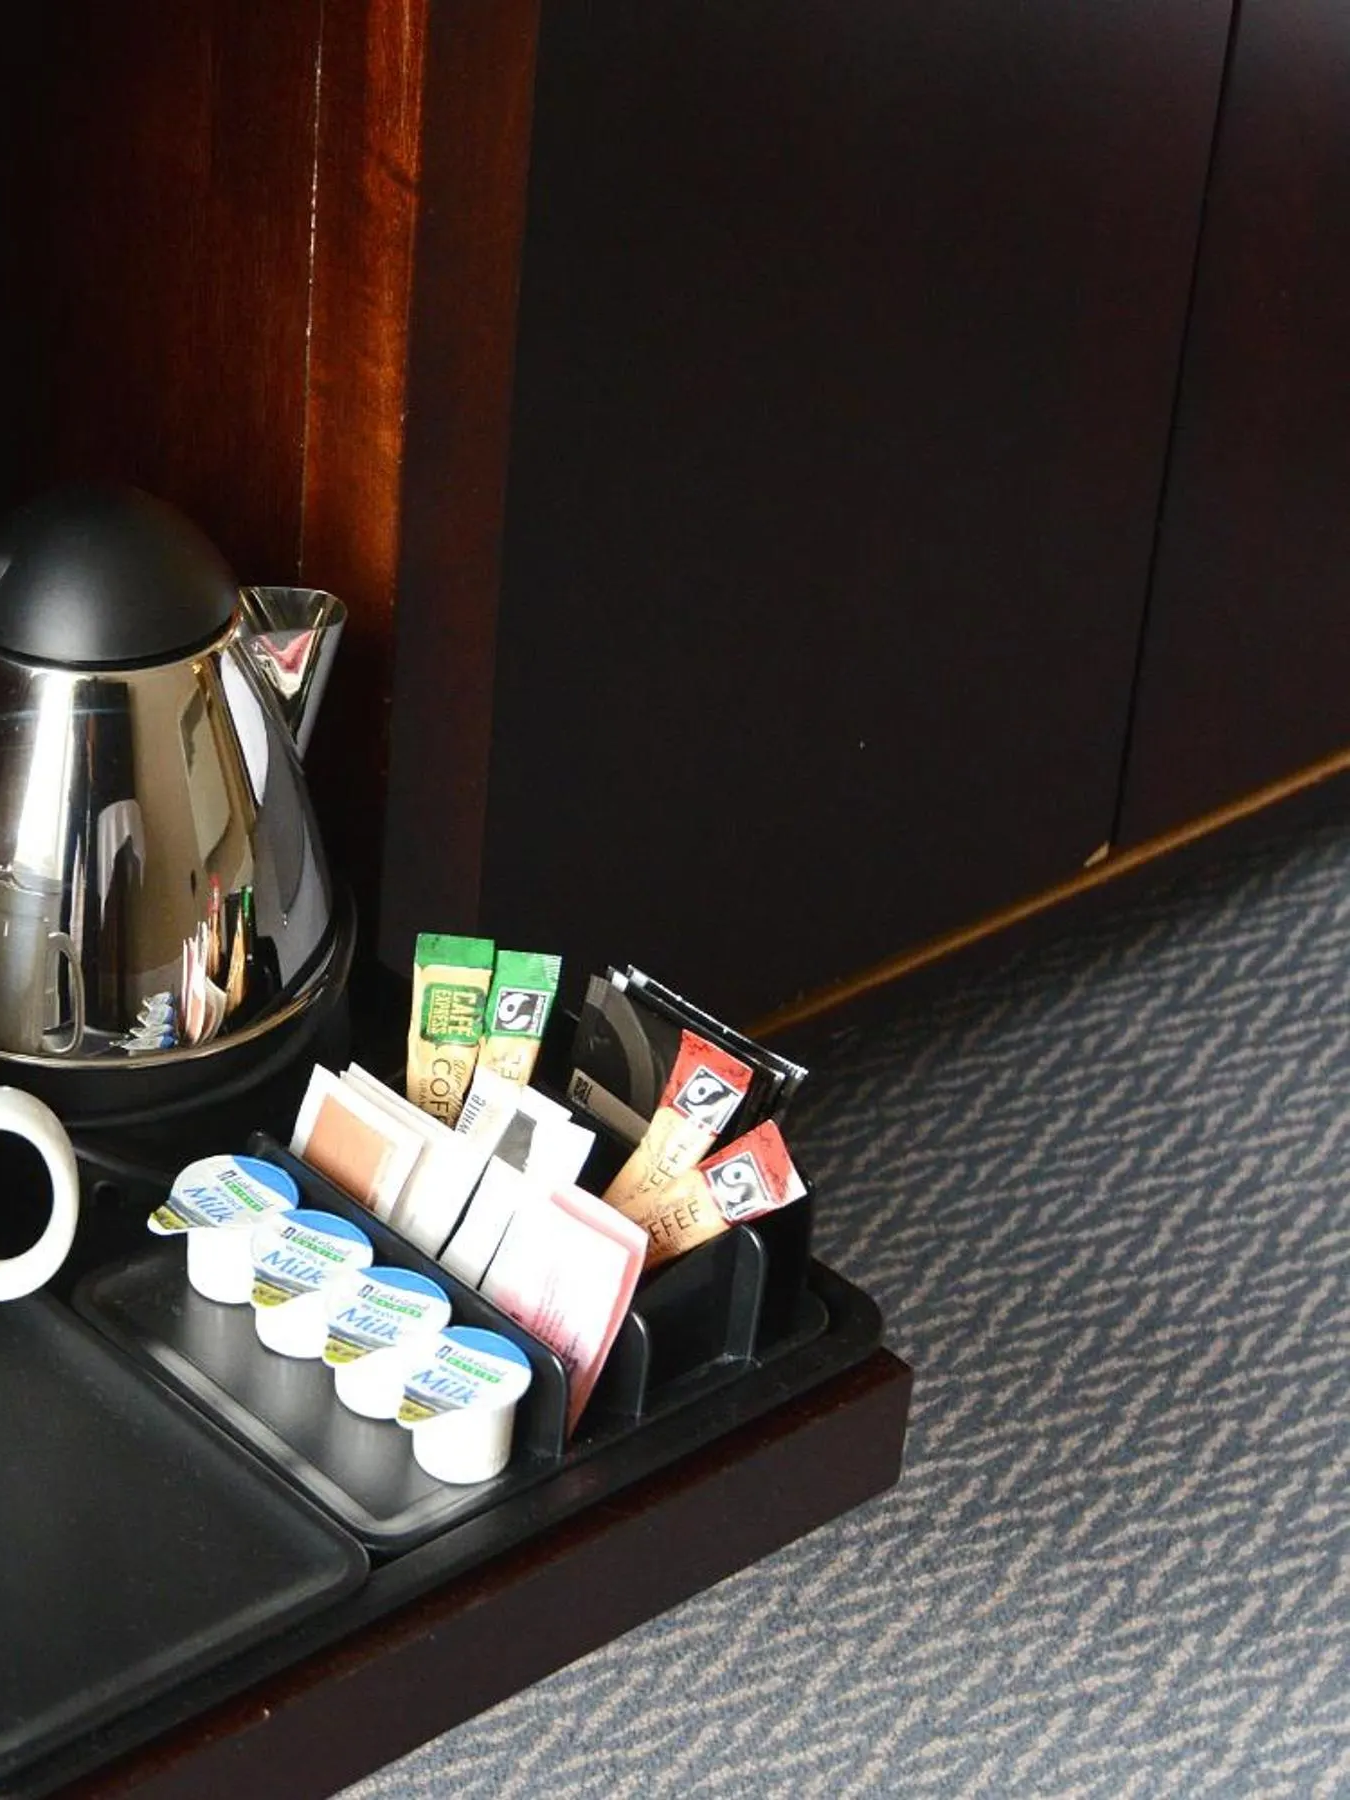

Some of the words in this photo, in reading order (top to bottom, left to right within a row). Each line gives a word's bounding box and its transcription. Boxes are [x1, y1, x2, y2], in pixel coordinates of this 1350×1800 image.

[430, 988, 450, 1035] EXPRESS
[182, 1186, 235, 1223] Milk
[261, 1249, 326, 1285] Milk
[336, 1307, 402, 1341] Milk
[411, 1369, 478, 1405] Milk
